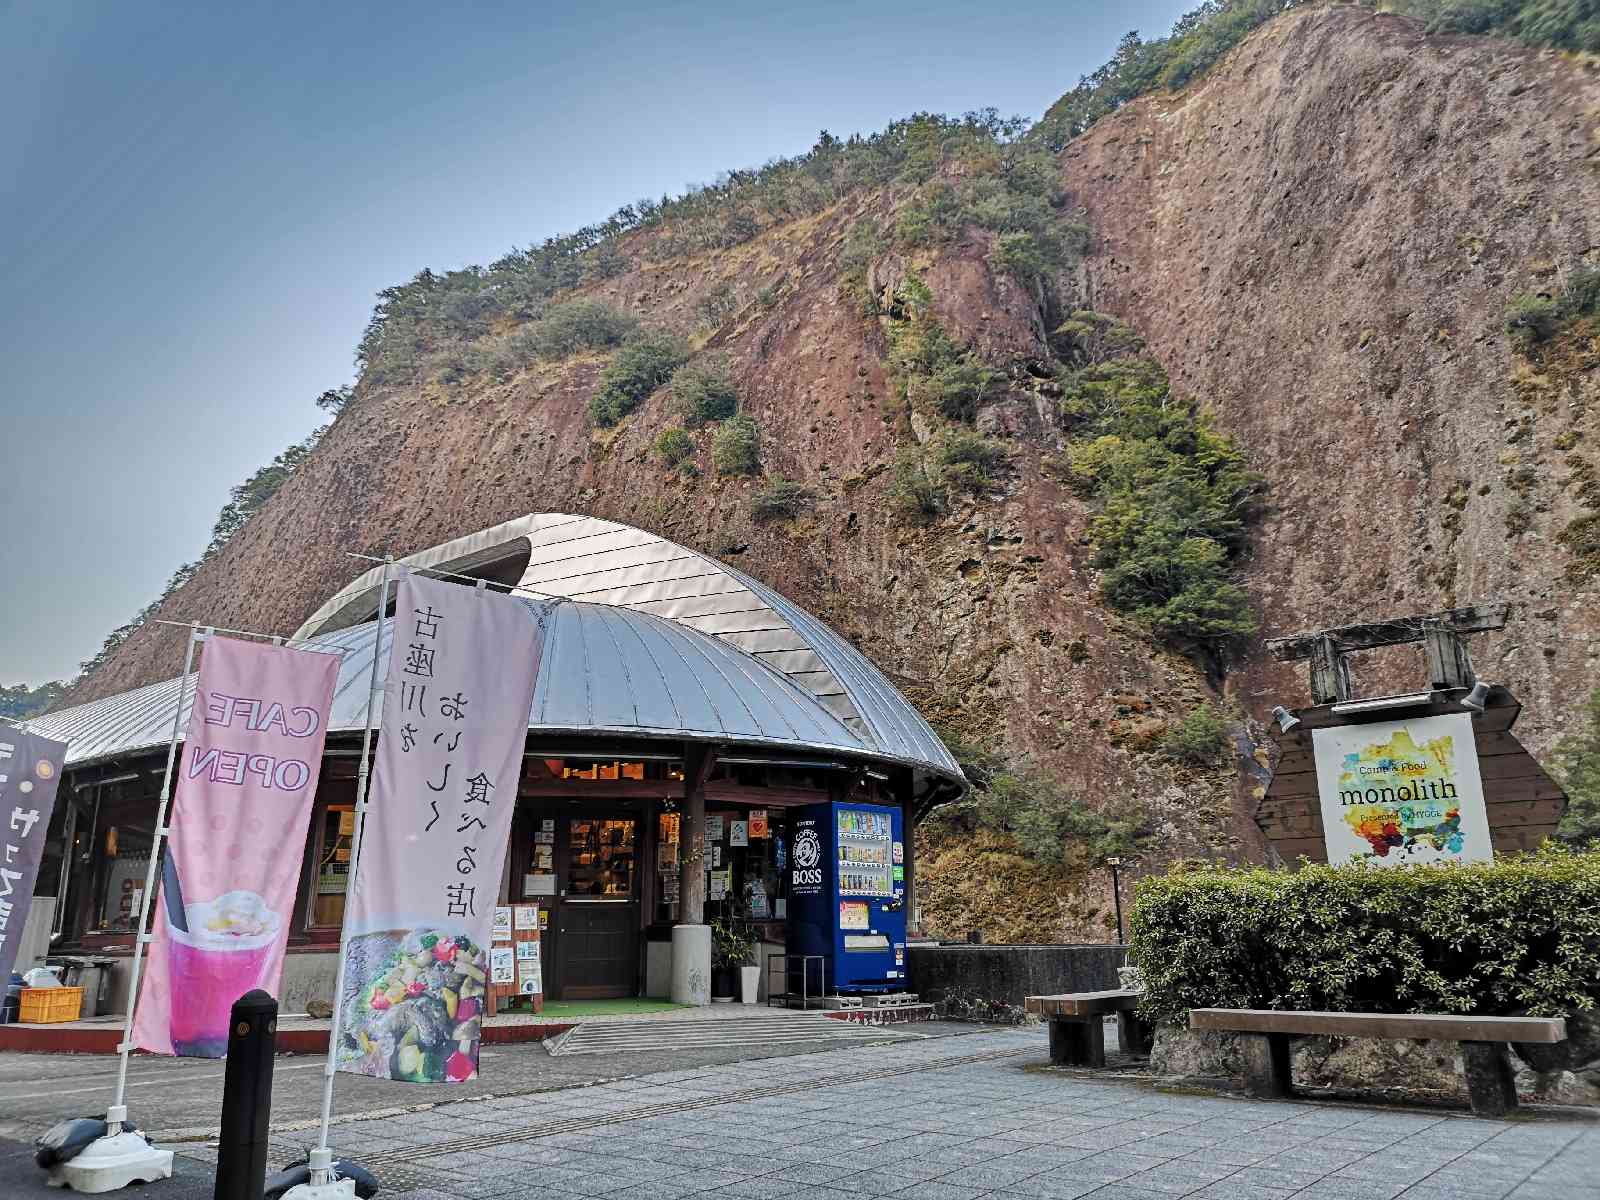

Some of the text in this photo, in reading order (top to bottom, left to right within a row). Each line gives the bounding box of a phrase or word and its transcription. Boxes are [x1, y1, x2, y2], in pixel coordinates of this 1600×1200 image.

[1401, 760, 1427, 772] Food
[1339, 778, 1458, 805] monolith
[795, 829, 818, 843] COFFEE
[792, 869, 822, 885] BOSS
